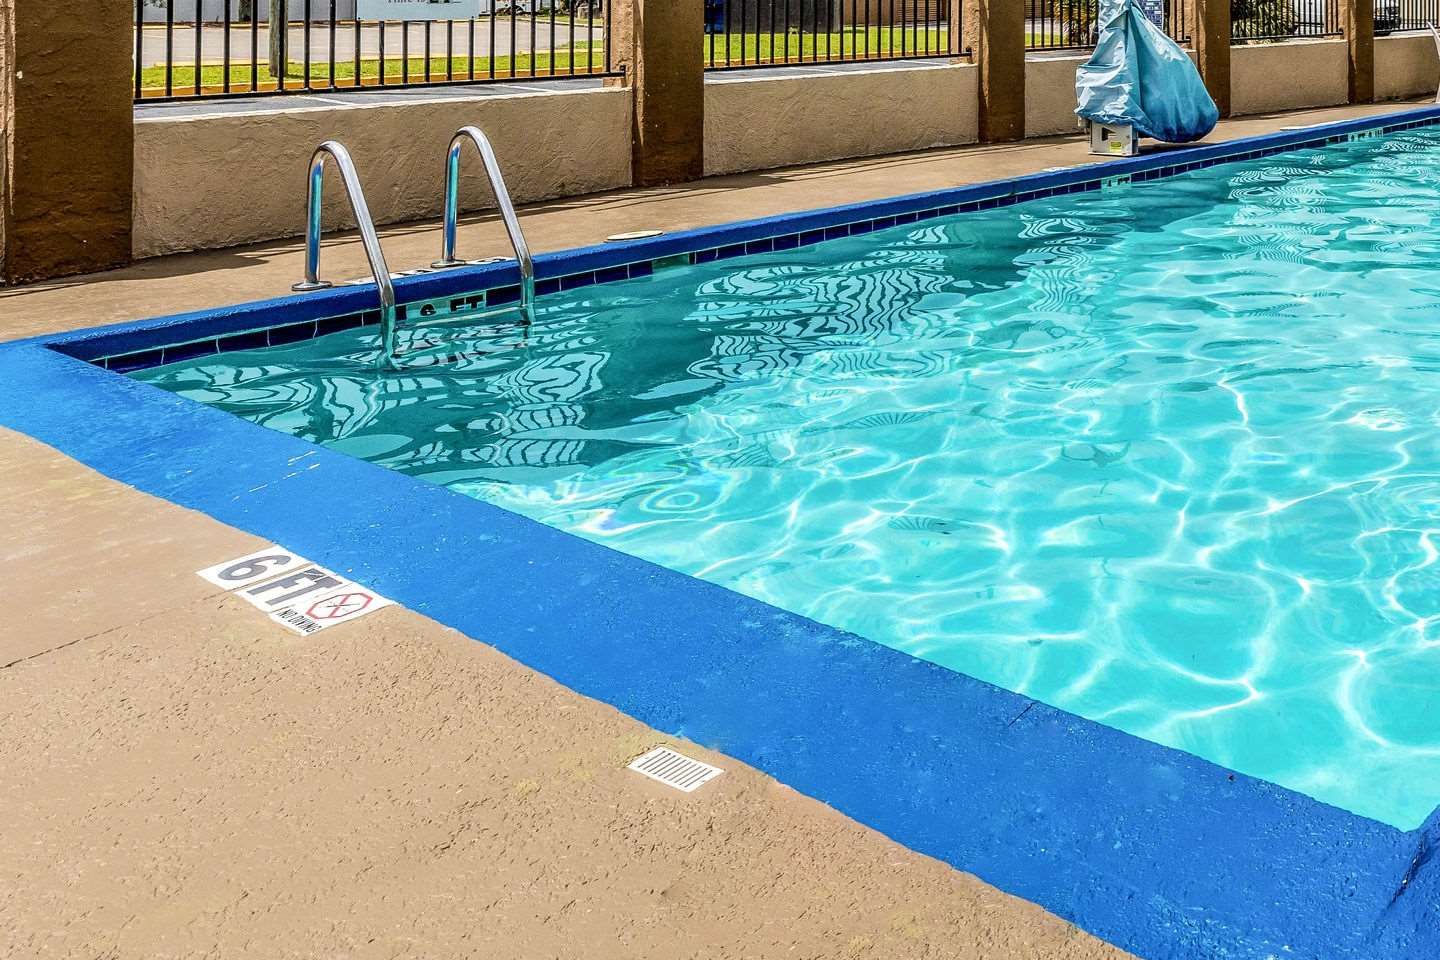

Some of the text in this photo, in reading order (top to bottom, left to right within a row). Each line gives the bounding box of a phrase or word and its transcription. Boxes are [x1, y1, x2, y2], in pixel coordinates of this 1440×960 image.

[450, 294, 484, 312] FT
[217, 554, 343, 606] 6 FT
[288, 615, 322, 633] DIVING
